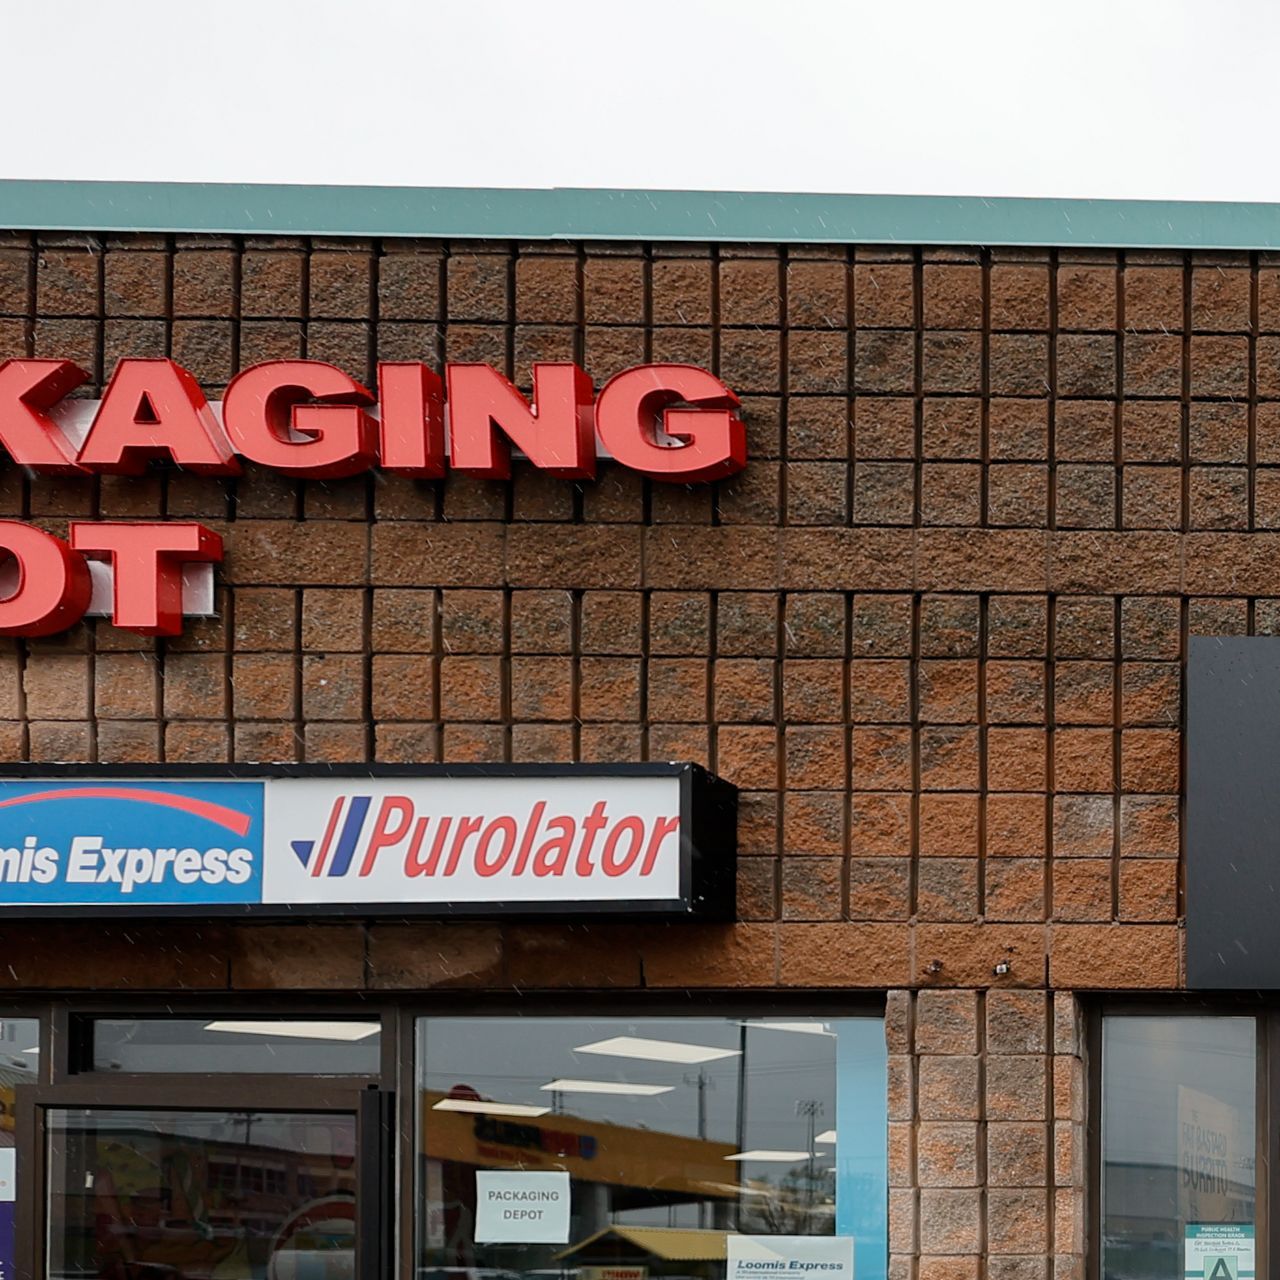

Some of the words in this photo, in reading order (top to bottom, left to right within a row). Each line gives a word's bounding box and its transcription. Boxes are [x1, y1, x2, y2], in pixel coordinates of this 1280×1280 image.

[360, 795, 681, 878] Purolator
[66, 836, 253, 893] Express
[1182, 1151, 1228, 1196] BURRITO
[488, 1190, 559, 1201] PACKAGING
[503, 1209, 544, 1220] DEPOT
[737, 1260, 786, 1270] Loomis
[788, 1261, 843, 1271] Express
